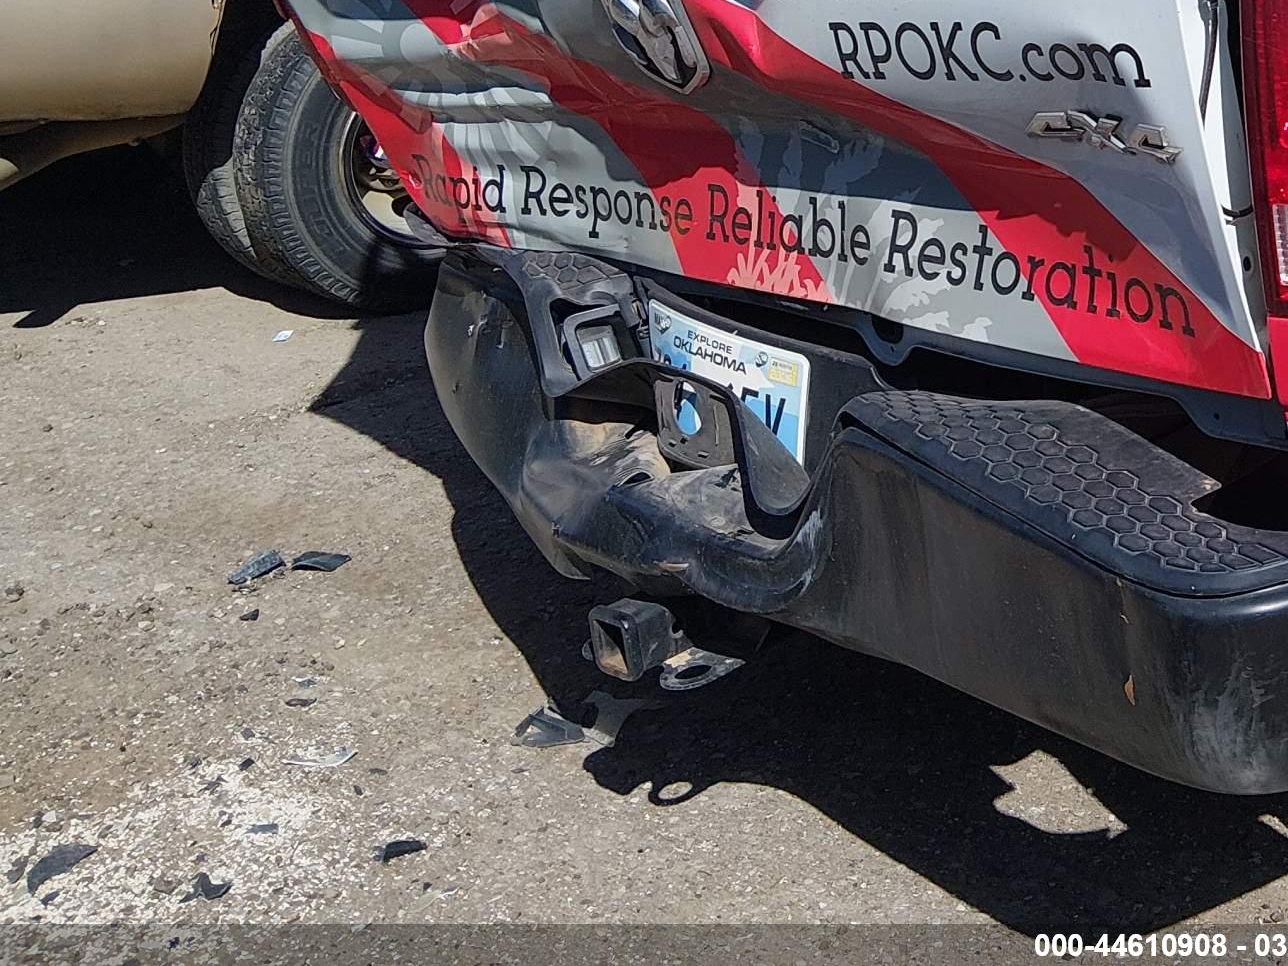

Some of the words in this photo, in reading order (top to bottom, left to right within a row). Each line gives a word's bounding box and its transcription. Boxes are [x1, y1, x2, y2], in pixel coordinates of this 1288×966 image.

[829, 20, 1152, 88] RPOKC.com
[411, 153, 506, 225] Rapid
[520, 165, 693, 239] Response
[706, 183, 871, 266] Reliable
[883, 209, 1196, 338] Restoration
[673, 335, 748, 375] OKLAHOMA
[687, 329, 733, 355] EXPLORE
